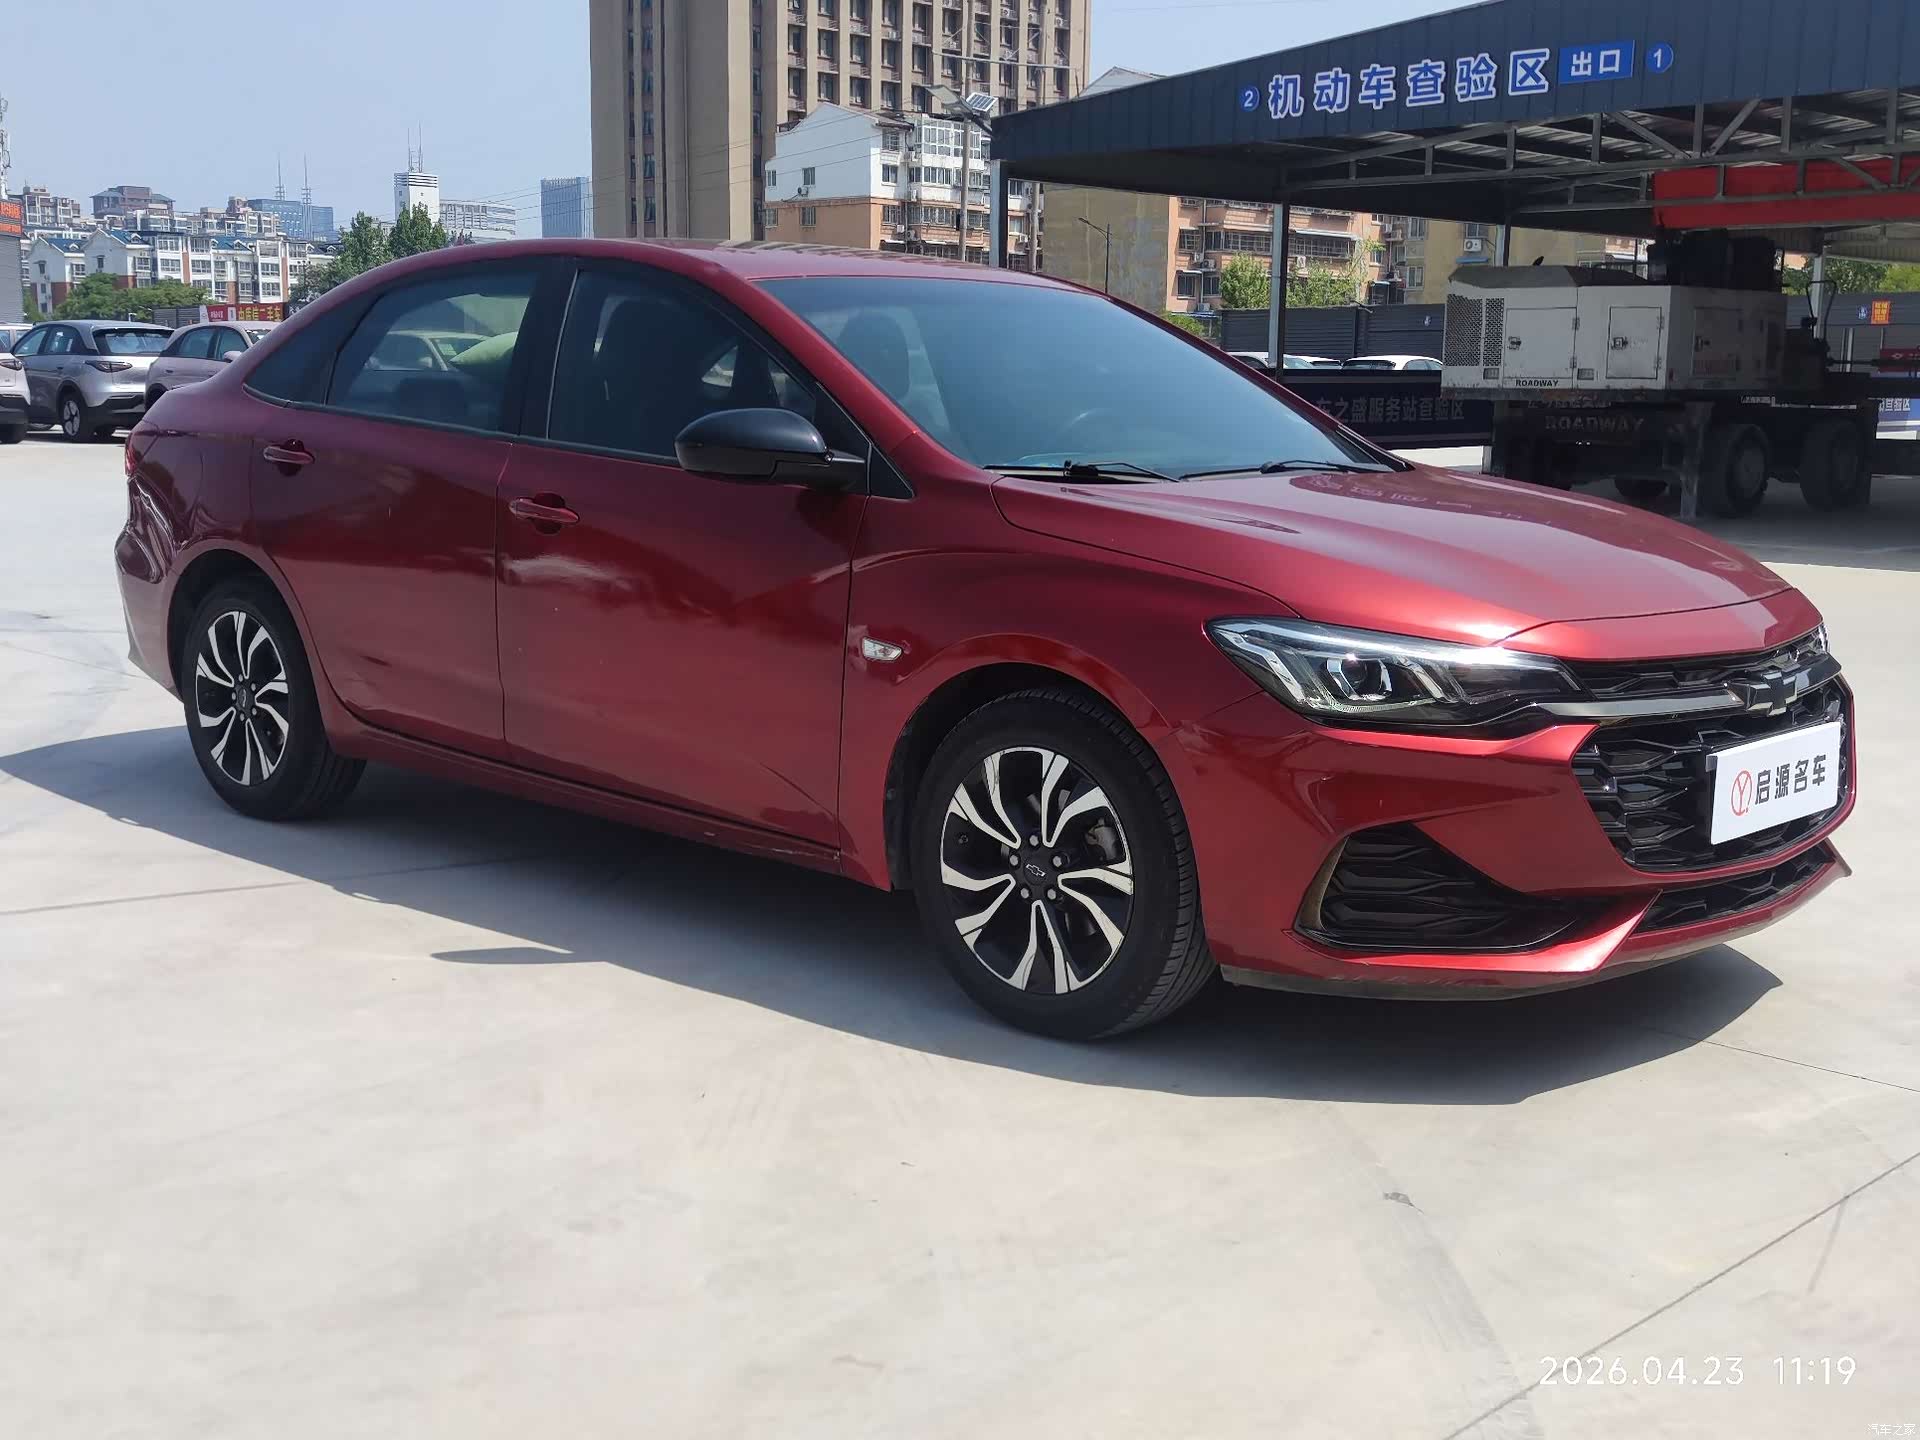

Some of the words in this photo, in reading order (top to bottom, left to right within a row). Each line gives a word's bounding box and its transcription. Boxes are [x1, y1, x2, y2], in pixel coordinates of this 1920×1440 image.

[1570, 48, 1622, 78] 出口
[1268, 48, 1550, 119] 机动车查验区
[1515, 379, 1559, 387] ROADWAY
[1755, 754, 1827, 805] 启源名车
